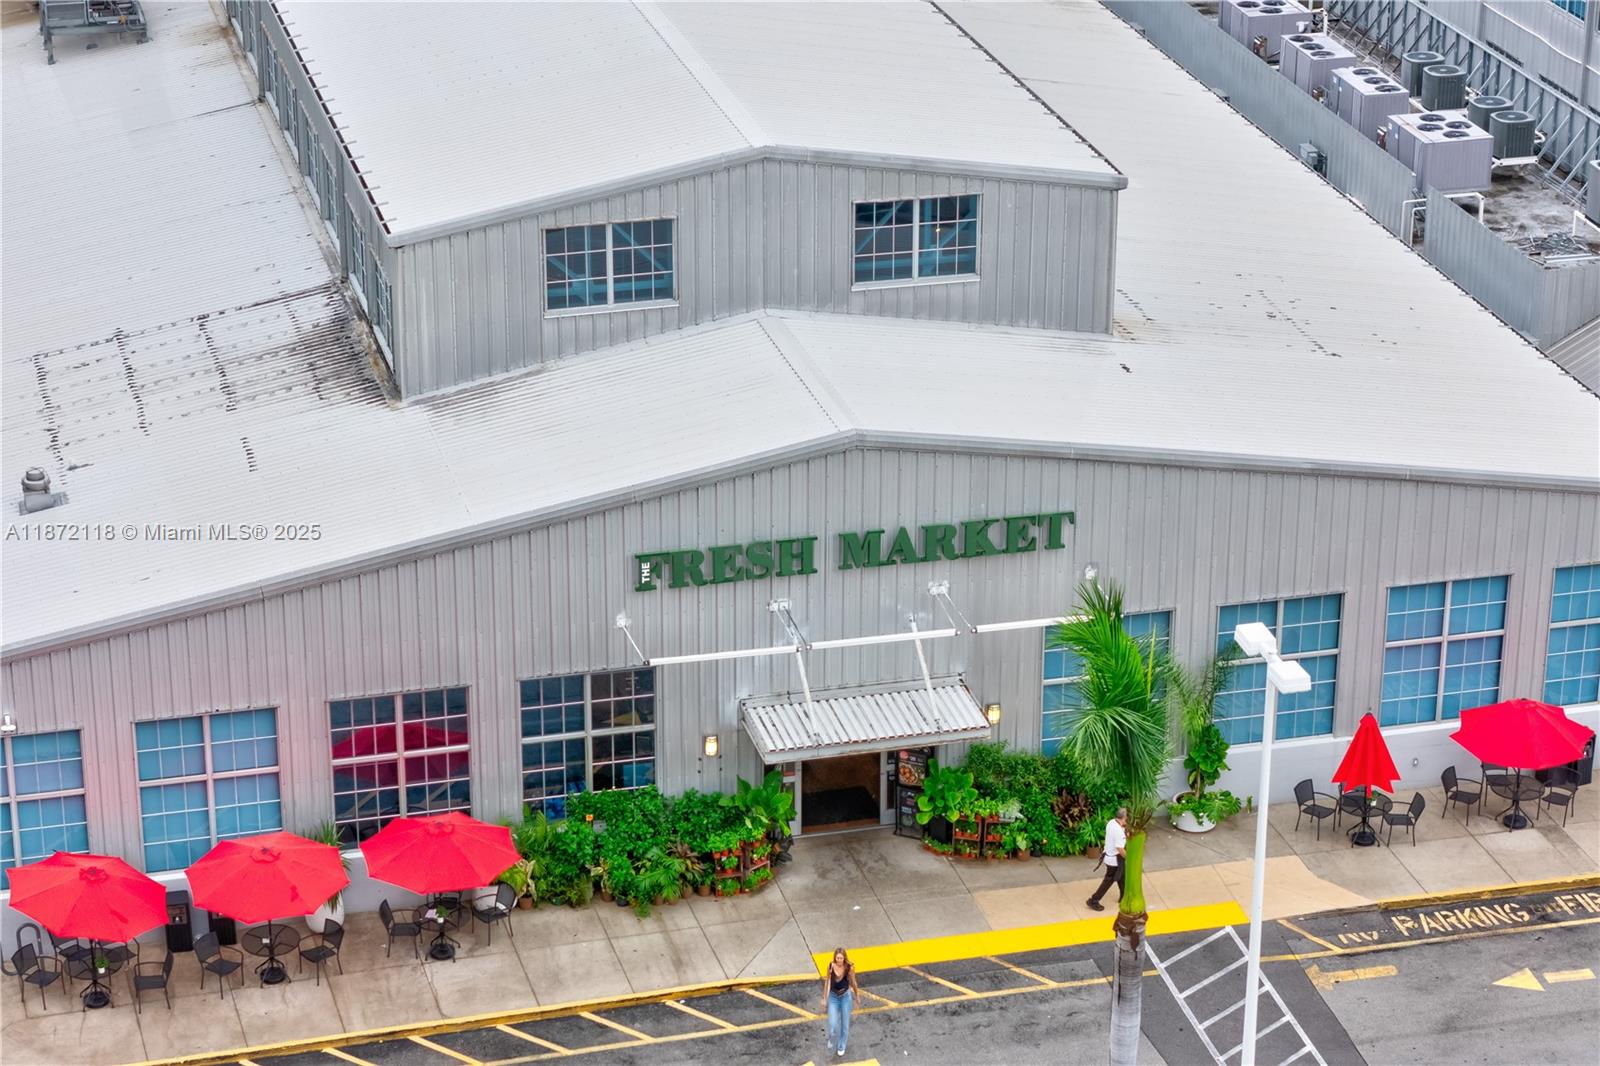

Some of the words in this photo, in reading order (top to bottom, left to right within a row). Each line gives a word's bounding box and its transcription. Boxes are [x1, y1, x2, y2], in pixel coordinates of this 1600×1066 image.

[634, 535, 818, 592] FRESH
[838, 510, 1075, 570] MARKET
[641, 562, 650, 584] THE
[1391, 902, 1530, 937] PARKING
